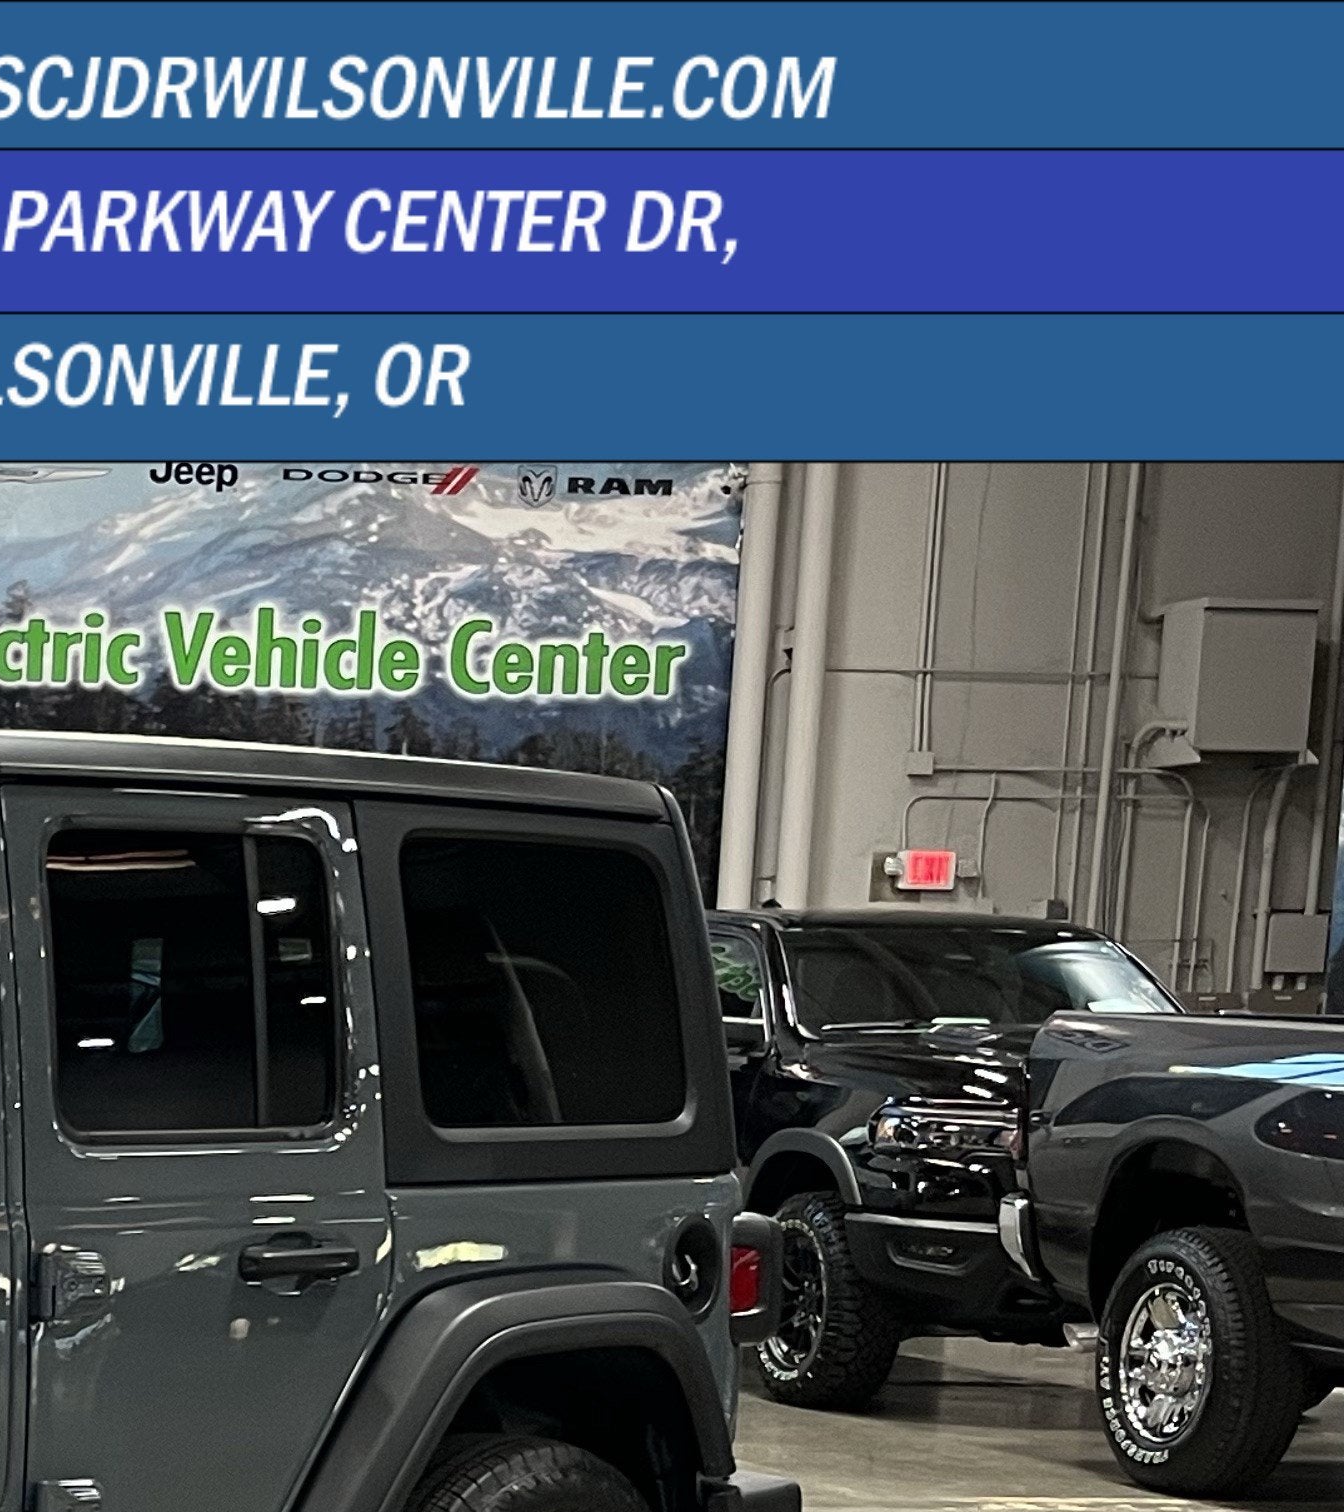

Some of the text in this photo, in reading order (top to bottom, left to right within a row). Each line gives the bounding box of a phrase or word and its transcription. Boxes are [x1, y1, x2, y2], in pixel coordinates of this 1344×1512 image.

[149, 462, 239, 492] Jeep
[281, 468, 449, 485] DODGE
[567, 477, 673, 496] RAM
[164, 606, 420, 692] Vehicle
[450, 618, 686, 696] Center
